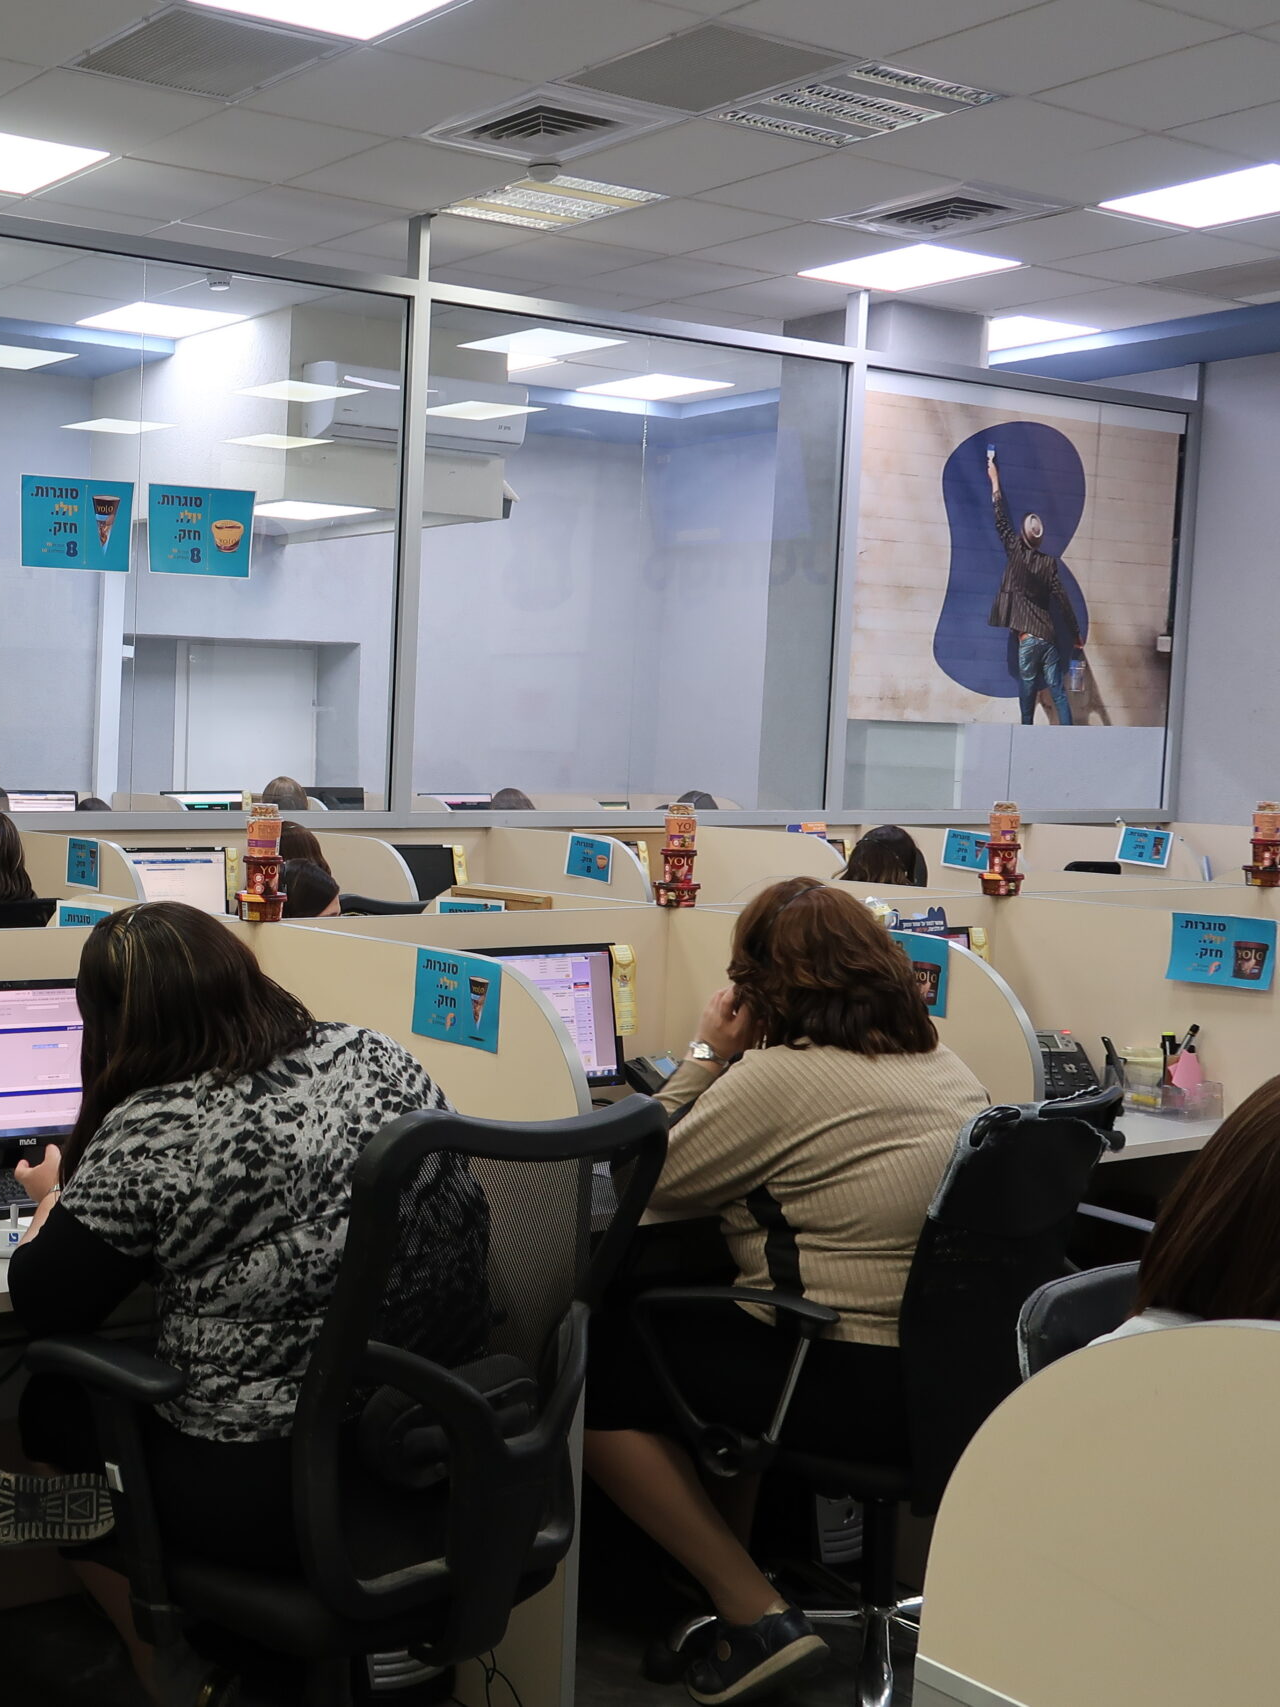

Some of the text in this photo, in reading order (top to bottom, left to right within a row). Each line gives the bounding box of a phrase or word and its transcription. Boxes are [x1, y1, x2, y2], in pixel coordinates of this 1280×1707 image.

[31, 486, 79, 499] סוגרות.
[158, 494, 202, 507] סוגרות.
[49, 522, 77, 536] חזק.
[174, 529, 200, 543] חזק.
[1180, 920, 1226, 931] סוגרות.
[1195, 947, 1223, 958] חזק.
[423, 959, 458, 975] סוגרות.
[434, 994, 456, 1008] חזק.
